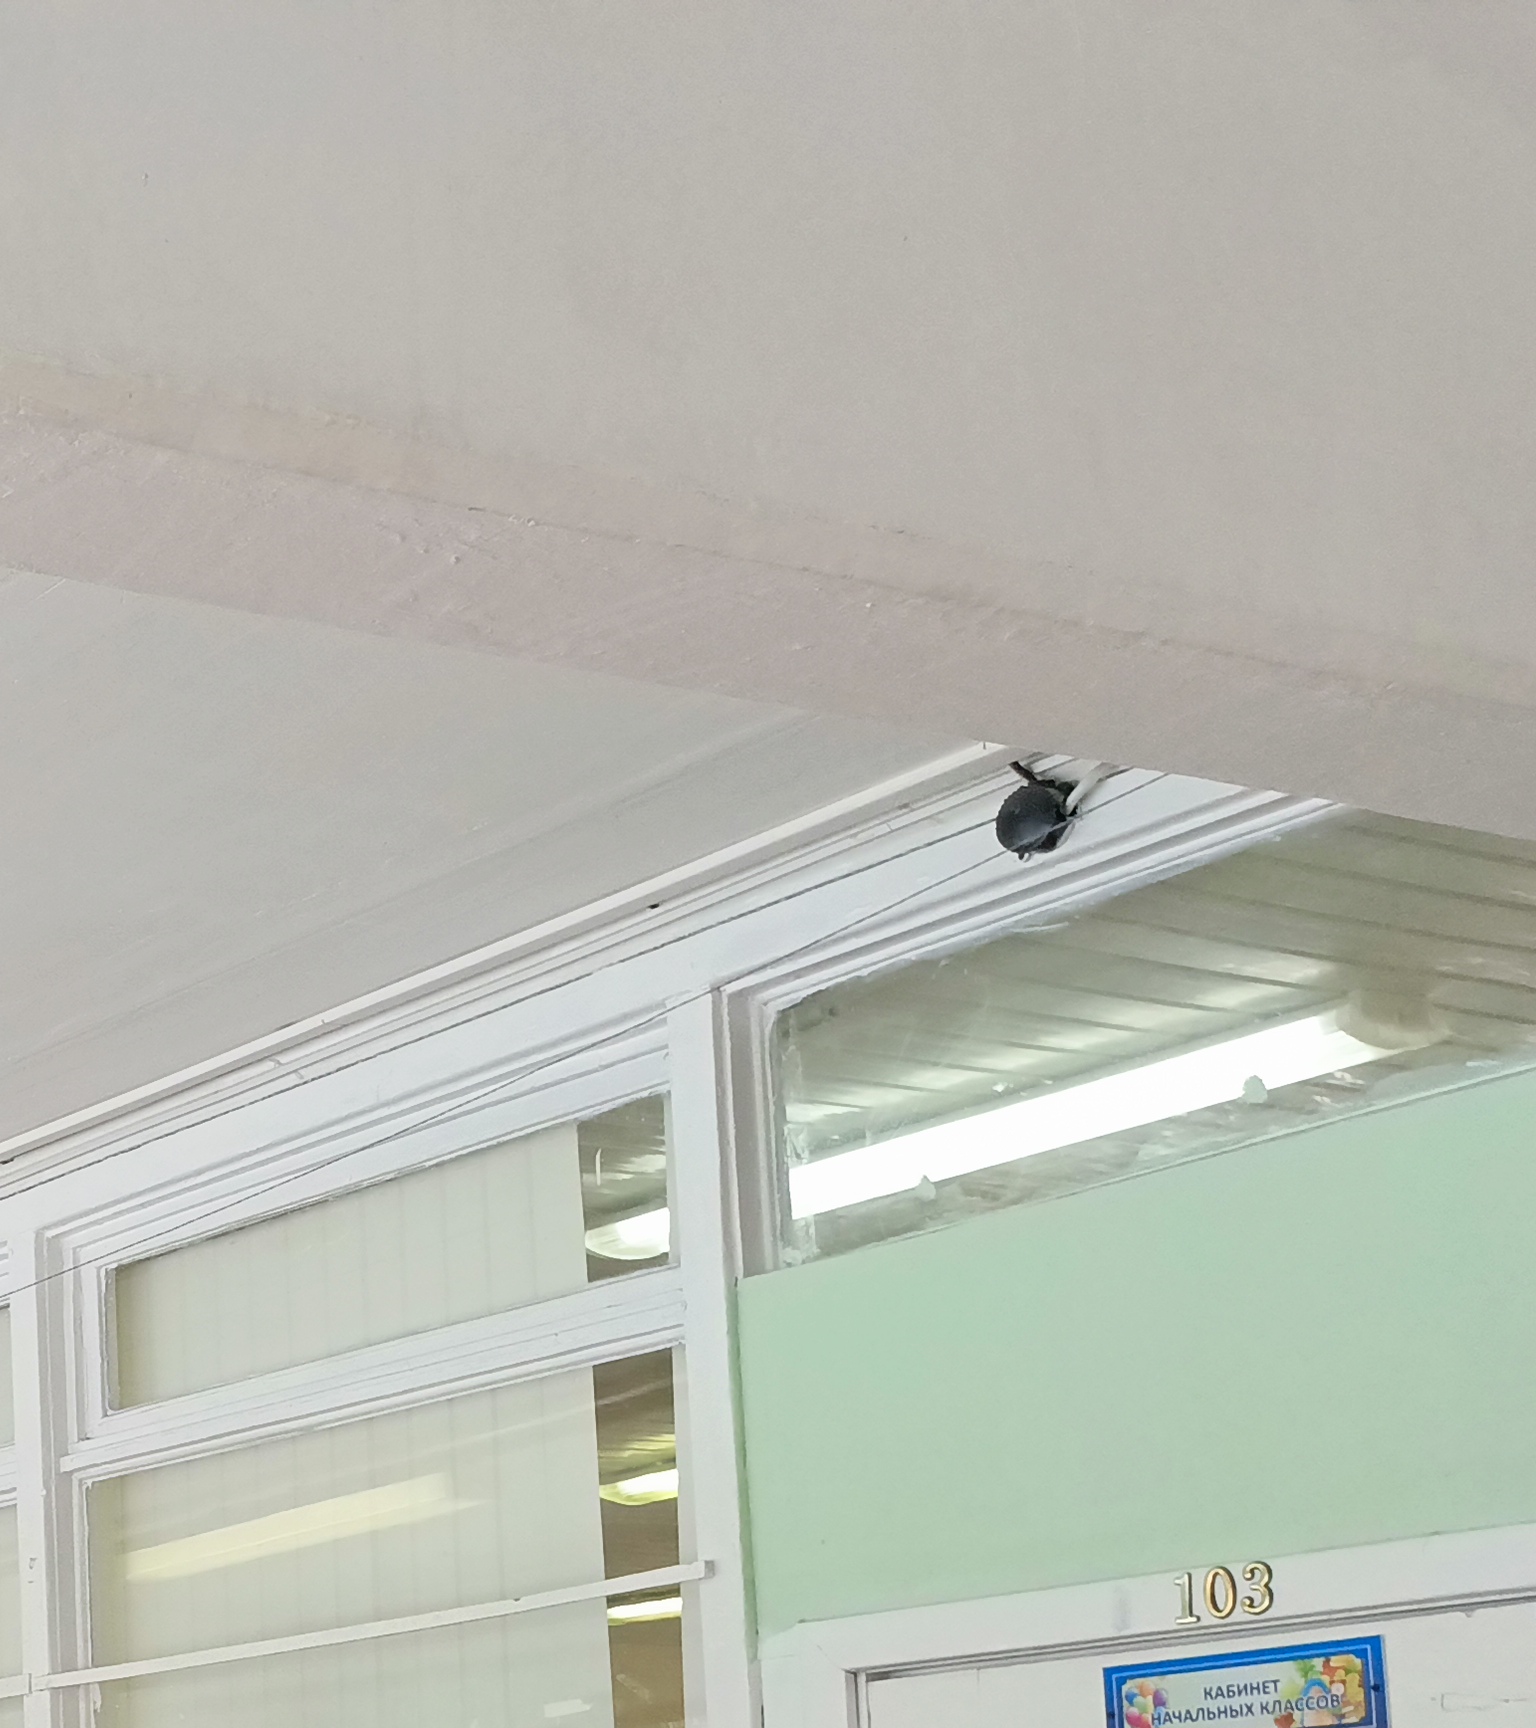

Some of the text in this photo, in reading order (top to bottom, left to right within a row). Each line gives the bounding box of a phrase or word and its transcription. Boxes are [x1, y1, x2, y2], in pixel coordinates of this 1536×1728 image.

[1174, 1561, 1274, 1625] 103
[1203, 1679, 1280, 1701] КАБИНЕТ
[1152, 1693, 1342, 1726] НАЧАЛЬНЫХ КЛАССОВ
